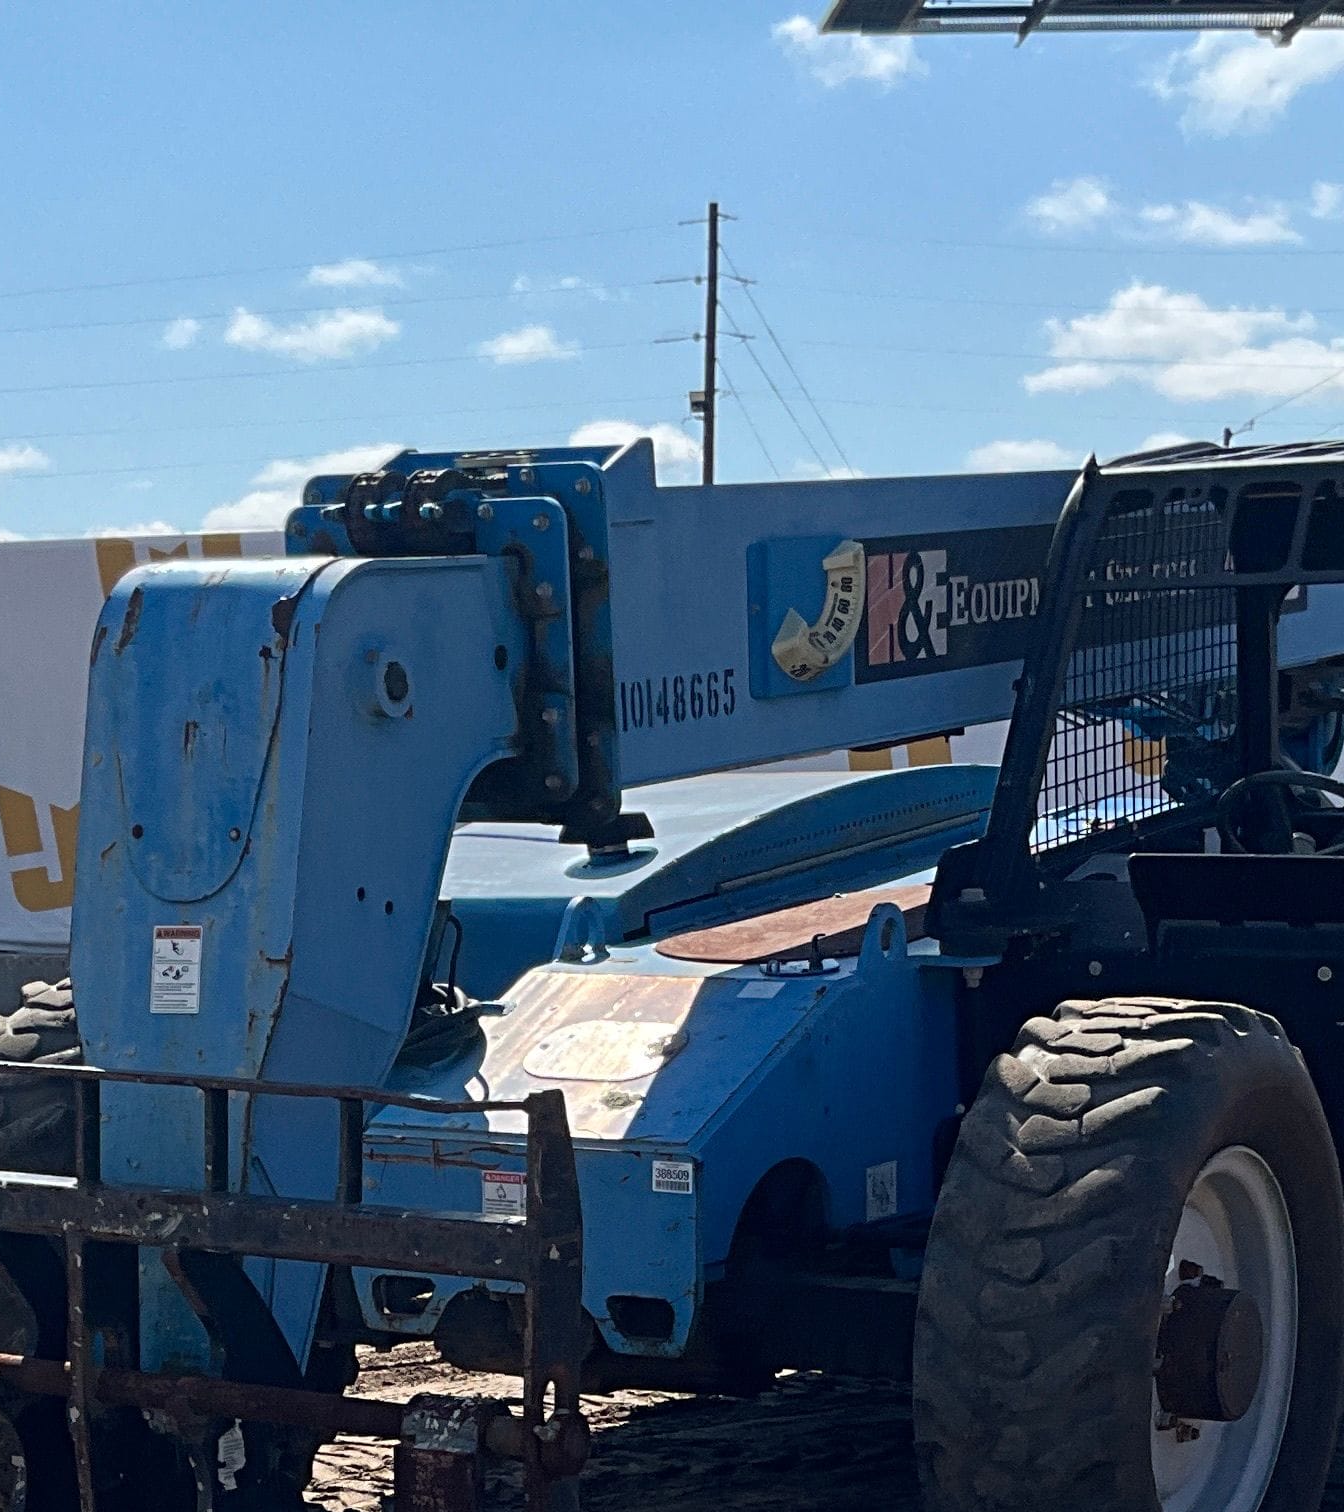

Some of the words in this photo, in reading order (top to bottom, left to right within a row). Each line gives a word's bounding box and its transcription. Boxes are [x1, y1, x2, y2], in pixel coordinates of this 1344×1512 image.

[620, 668, 736, 732] 10148665
[491, 1173, 520, 1183] DANGER
[655, 1167, 690, 1181] 388509
